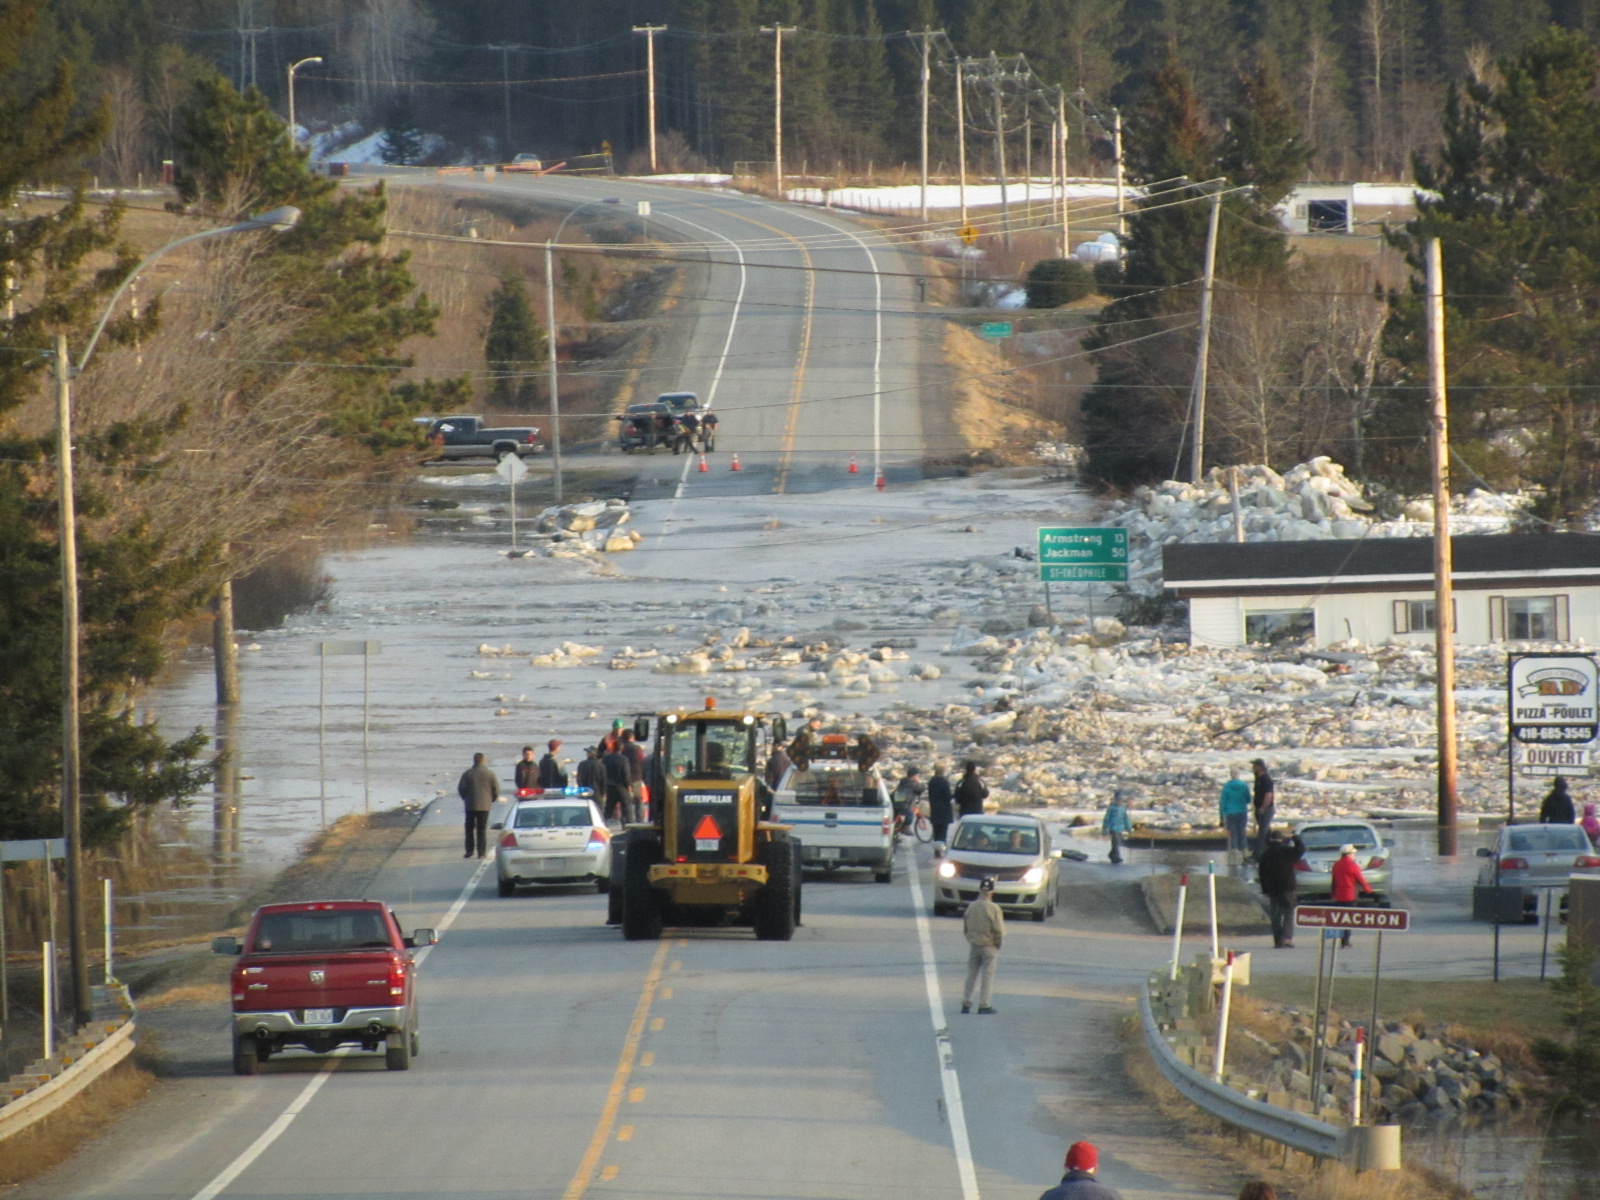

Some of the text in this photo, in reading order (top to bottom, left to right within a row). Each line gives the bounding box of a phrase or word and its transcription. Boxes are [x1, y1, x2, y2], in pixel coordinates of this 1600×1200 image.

[1043, 533, 1103, 545] Armstrong
[1043, 547, 1126, 558] Jackman 50
[1517, 707, 1546, 718] PIZZA
[1527, 749, 1584, 764] OUVERT
[684, 794, 733, 803] CATERPILLAR
[1331, 911, 1400, 926] VACHON
